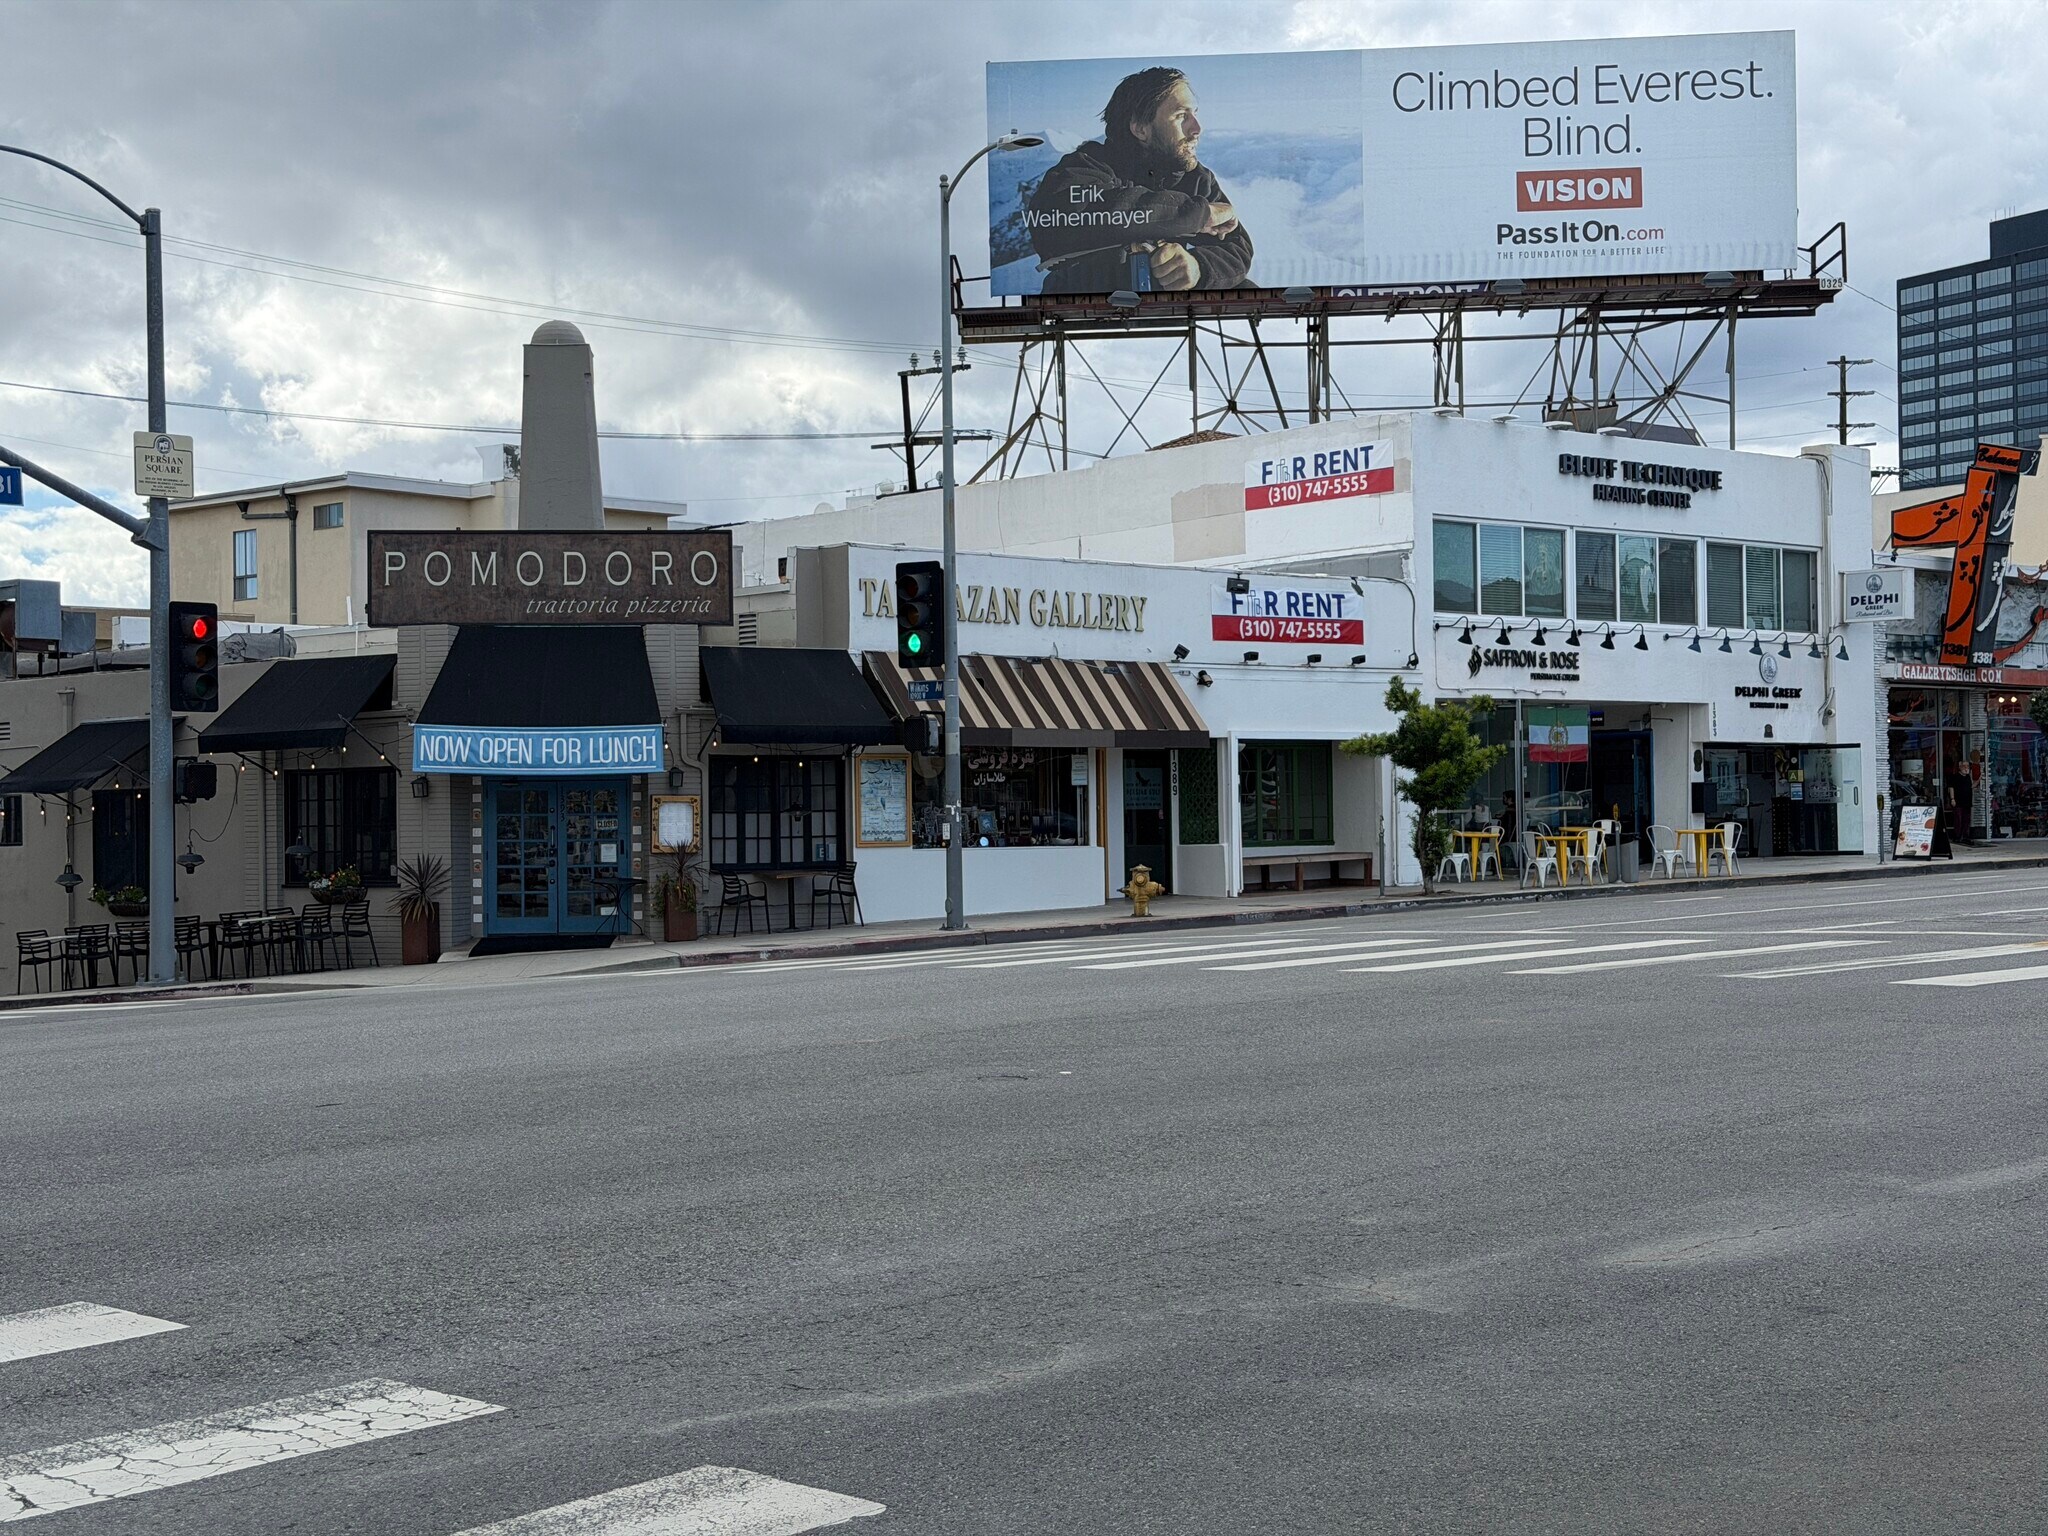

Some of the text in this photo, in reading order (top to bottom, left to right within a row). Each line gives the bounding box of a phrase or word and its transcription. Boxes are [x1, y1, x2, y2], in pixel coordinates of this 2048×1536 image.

[1393, 60, 1773, 113] Climbed Everest.
[1523, 114, 1642, 158] Blind.
[1069, 184, 1105, 204] Erik
[1524, 176, 1633, 203] VISION
[1021, 208, 1153, 229] Weihenmayer
[1497, 251, 1514, 260] THE
[1518, 249, 1578, 259] FOUNDATION
[1600, 248, 1606, 256] A
[1610, 247, 1642, 256] BETTER
[1646, 246, 1665, 255] LIFE
[1820, 278, 1843, 289] 0325
[144, 454, 184, 465] PERSIAN
[145, 463, 183, 475] SQUARE
[1313, 445, 1374, 478] RENT
[1558, 453, 1723, 492] BLUFF TECHNIQUE
[1268, 474, 1368, 506] (310) 747-5555
[1592, 483, 1692, 509] HEALING CENTER
[384, 550, 718, 587] POMODORO
[525, 596, 713, 618] trattoria pizzeria
[1029, 588, 1149, 633] GALLERY
[1286, 591, 1346, 619] RENT
[1850, 593, 1899, 606] DELPHI
[1239, 618, 1342, 640] (310) 747-5555
[1483, 648, 1580, 670] SAFFRON & ROSE
[1972, 651, 1994, 664] 1381
[1735, 686, 1803, 699] DELPHI GREEK
[420, 735, 656, 764] NOW OPEN FOR LUNCH
[1790, 772, 1797, 780] A
